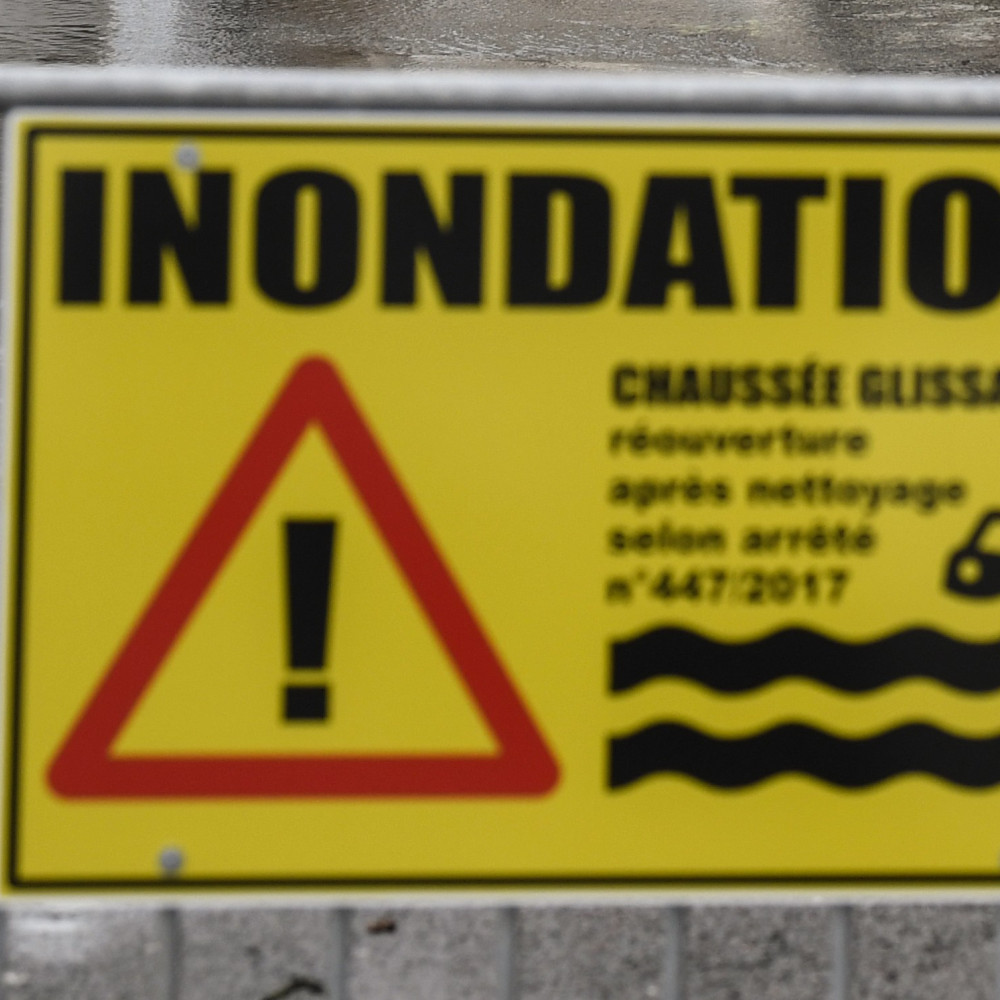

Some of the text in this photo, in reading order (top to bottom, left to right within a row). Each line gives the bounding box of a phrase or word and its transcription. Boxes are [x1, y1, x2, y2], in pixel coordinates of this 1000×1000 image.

[611, 356, 842, 408] CHAUSSÉE
[609, 426, 868, 456] réouverture
[609, 475, 967, 513] après nettoyage
[608, 518, 876, 554] selon arrêté
